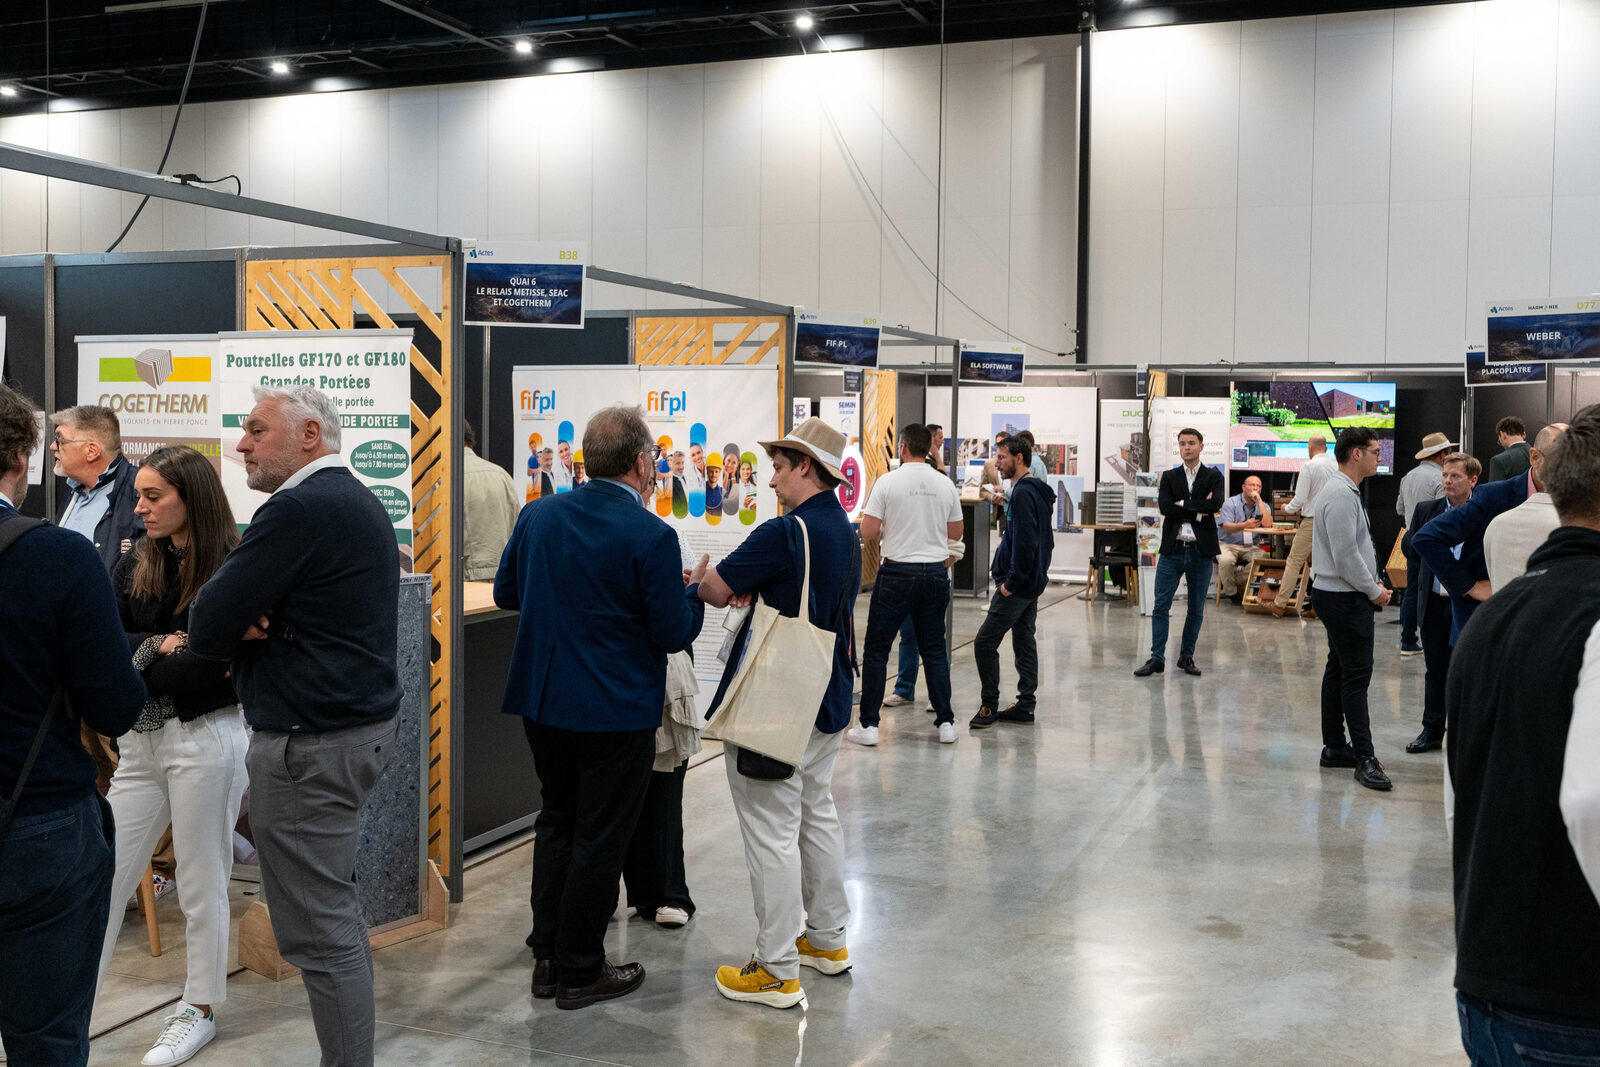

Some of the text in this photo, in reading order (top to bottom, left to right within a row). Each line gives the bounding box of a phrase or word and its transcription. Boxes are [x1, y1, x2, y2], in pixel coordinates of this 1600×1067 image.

[559, 250, 578, 260] B38
[510, 277, 537, 286] QUAI 6
[476, 287, 568, 297] LE RELAIS METISSE, SEAC
[493, 298, 552, 307] ET COGETHERM
[1576, 301, 1596, 310] D77
[1526, 331, 1561, 341] WEBER
[825, 339, 848, 348] FIF PL
[226, 351, 406, 368] Poutrelles GF170 et GF180
[1481, 366, 1532, 375] PLACOPLATRE
[319, 374, 371, 389] Portées
[345, 396, 375, 409] portée
[520, 390, 556, 414] fifpl
[647, 390, 686, 416] fifpl
[186, 418, 209, 426] PONCE
[360, 416, 399, 427] PORTEE
[371, 442, 383, 450] SANS
